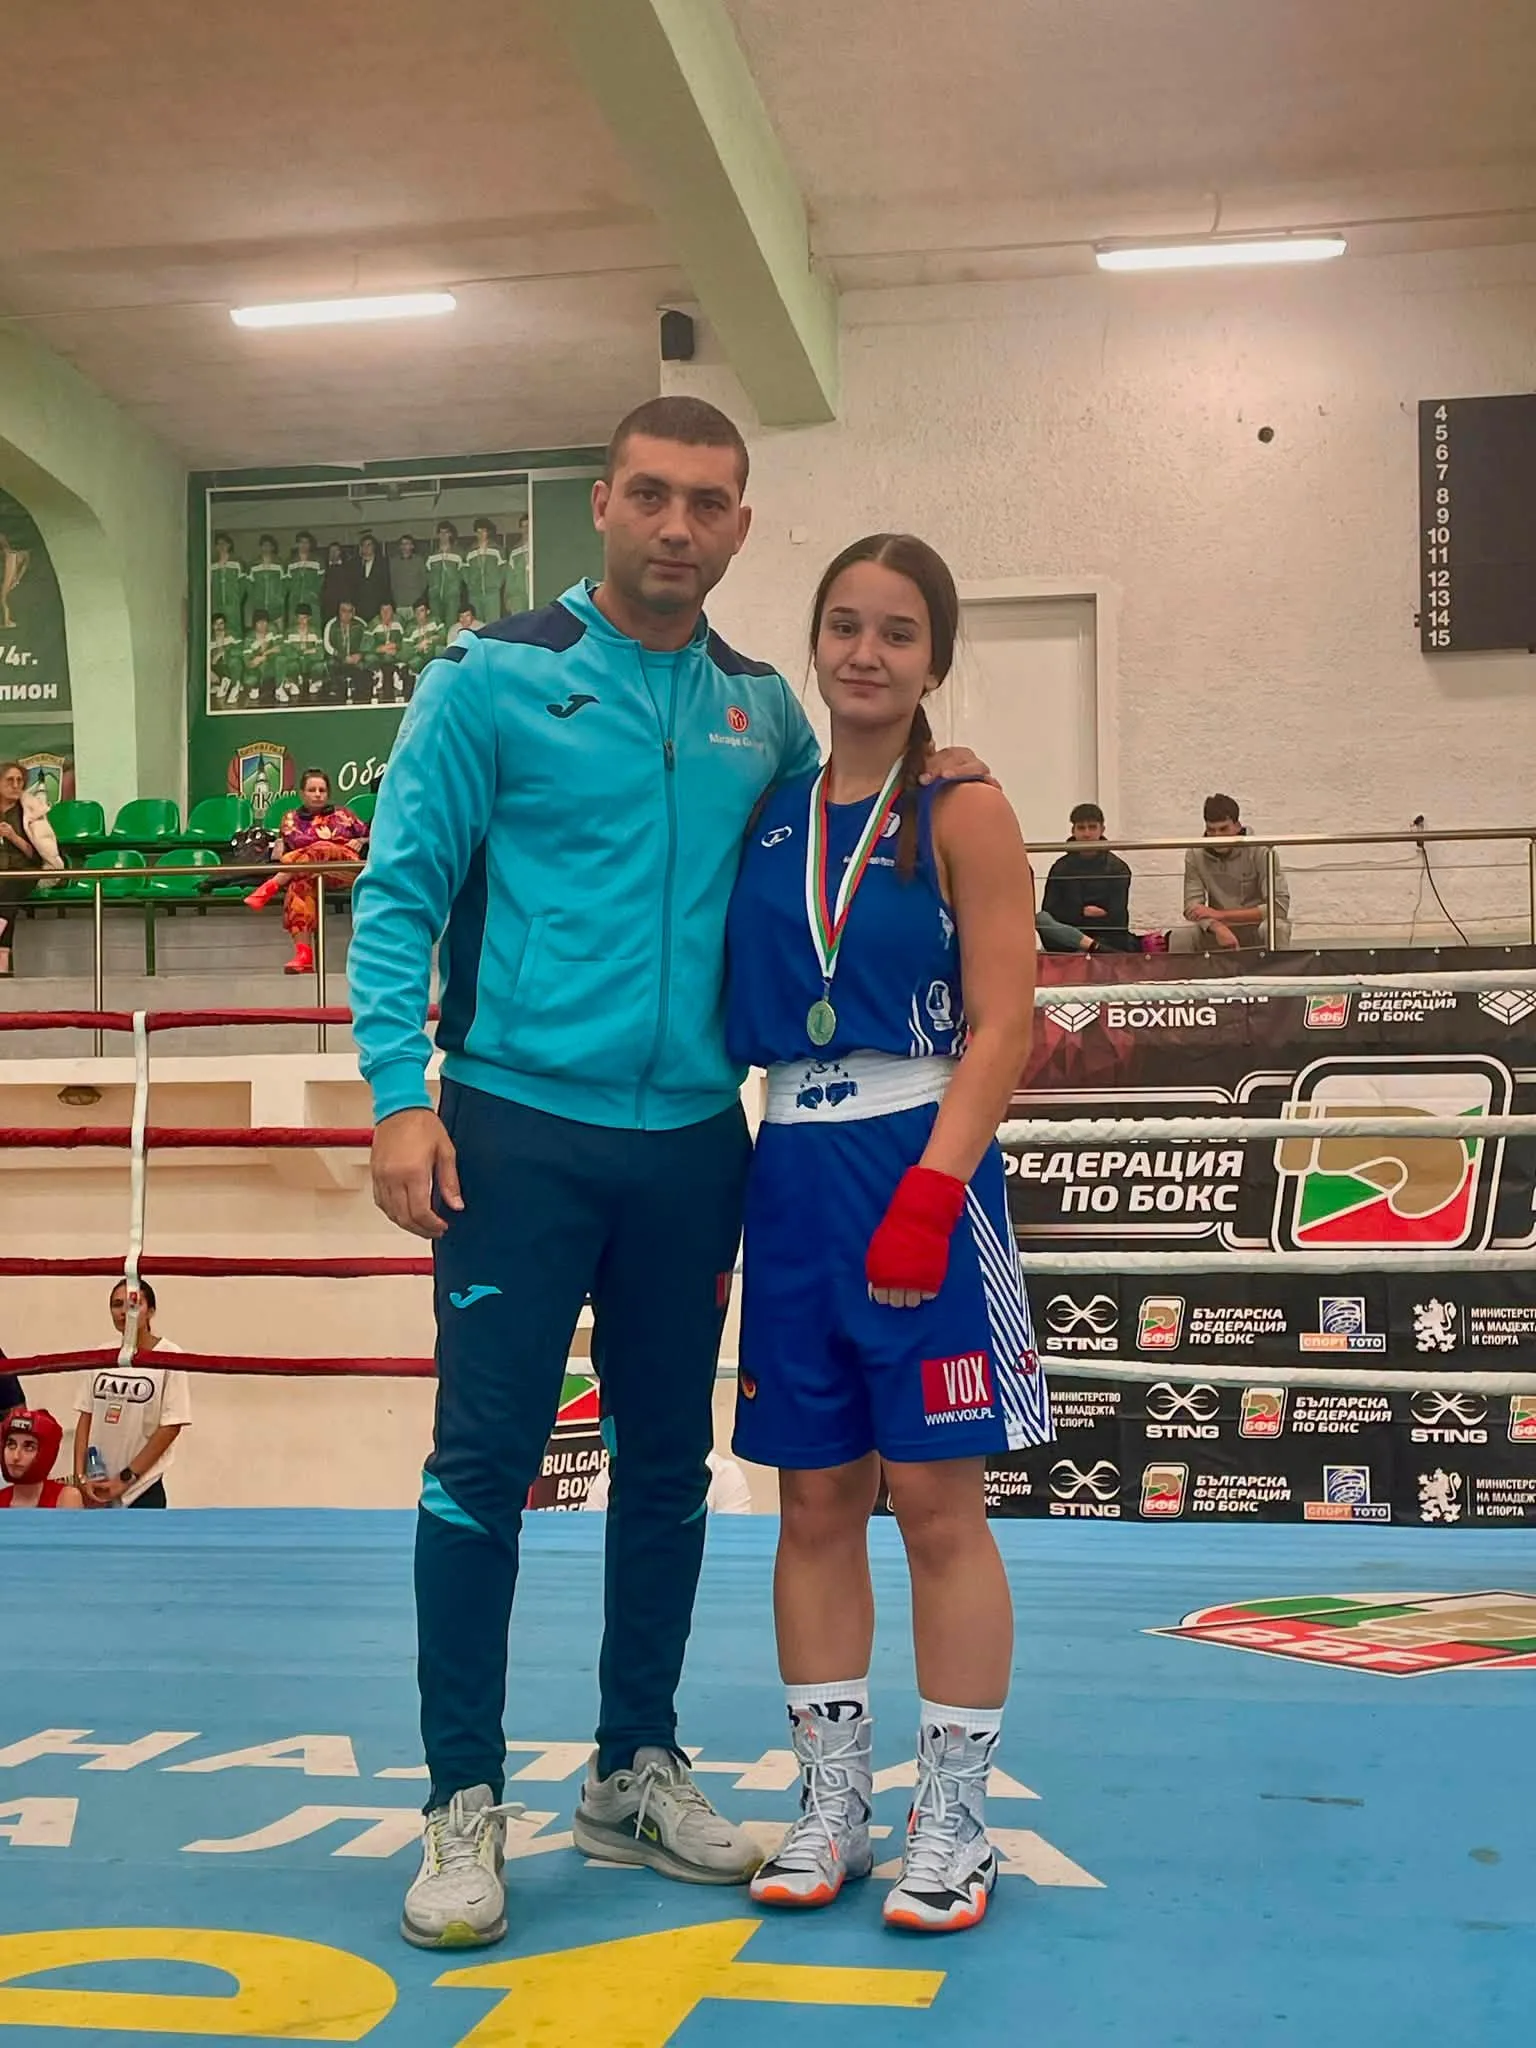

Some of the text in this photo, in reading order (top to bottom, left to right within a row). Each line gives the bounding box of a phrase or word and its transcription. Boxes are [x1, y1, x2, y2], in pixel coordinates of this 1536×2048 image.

[1434, 405, 1448, 421] 4
[1435, 425, 1449, 441] 5
[1435, 444, 1449, 461] 6
[1436, 464, 1449, 481] 7
[1436, 488, 1450, 504] 8
[1437, 508, 1450, 524] 9
[1427, 527, 1450, 544] 10
[1428, 547, 1449, 564] 11
[1428, 570, 1450, 587] 12
[1428, 590, 1451, 607] 13
[1428, 610, 1451, 627] 14
[1428, 630, 1451, 647] 15
[0, 683, 58, 701] пион
[1358, 998, 1457, 1011] ФЕДЕРАЦИЯ
[1108, 1007, 1217, 1028] BOXING
[1310, 1012, 1343, 1022] БФБ
[1357, 1011, 1425, 1022] ПО БОКС
[1001, 1151, 1244, 1183] ФЕДЕРАЦИЯ
[1061, 1184, 1240, 1212] ПО БОКС
[1192, 1308, 1284, 1320] БЪЛГАРСКА
[1189, 1320, 1288, 1333] ФЕДЕРАЦИЯ
[1471, 1321, 1536, 1333] НА МЛАДЕЖТ
[1046, 1337, 1119, 1351] STING
[1142, 1332, 1175, 1344] БФБ
[1189, 1333, 1255, 1345] ПО БОКС
[1350, 1338, 1382, 1347] ТОТО
[1471, 1335, 1519, 1345] И СПОРТА
[943, 1356, 989, 1405] VOX
[1050, 1391, 1121, 1402] МИНИСТЕРСТВО
[1296, 1397, 1389, 1409] БЪЛГАРСКА
[925, 1407, 996, 1427] WWW.VOX.PL
[1050, 1405, 1116, 1416] НА МЛАДЕЖТА
[1292, 1409, 1392, 1422] ФЕДЕРАЦИЯ
[1059, 1418, 1095, 1428] СПОРТА
[1245, 1420, 1278, 1432] БФБ
[1292, 1422, 1360, 1433] ПО БОКС
[1146, 1424, 1219, 1438] STING
[1411, 1428, 1488, 1444] STING
[1196, 1475, 1288, 1488] БЪЛГАРСКА
[1194, 1487, 1291, 1501] ФЕДЕРАЦИЯ
[1476, 1492, 1536, 1504] НА МЛАДЕЖ
[1049, 1503, 1121, 1517] STING
[1145, 1499, 1178, 1512] БФБ
[1192, 1500, 1259, 1512] ПО БОКС
[1476, 1506, 1525, 1516] И СПОРТА
[1354, 1507, 1387, 1518] ТОТО
